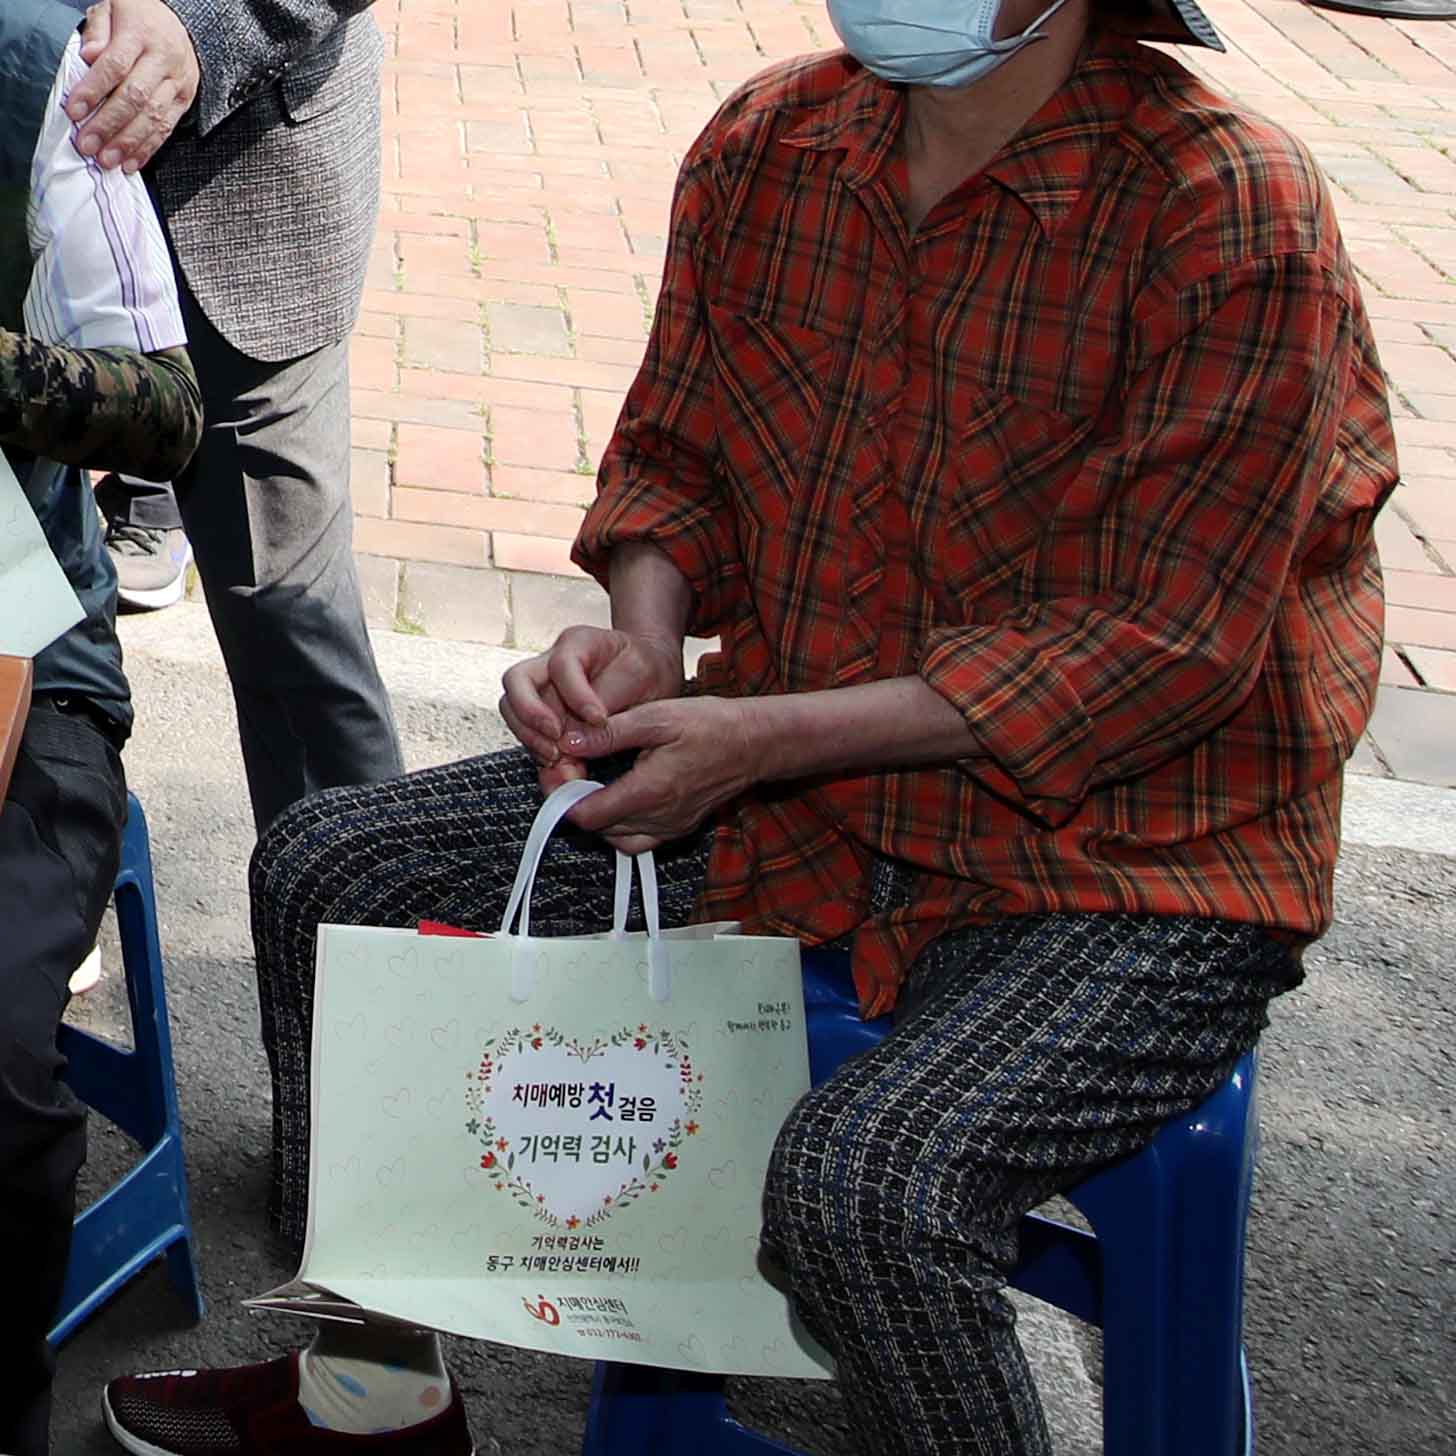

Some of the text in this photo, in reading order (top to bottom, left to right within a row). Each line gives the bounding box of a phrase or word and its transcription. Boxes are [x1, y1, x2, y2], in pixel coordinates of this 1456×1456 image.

[512, 1082, 585, 1108] 치매예방
[519, 1134, 637, 1165] 기억력 검사
[531, 1235, 605, 1251] 기억력검사는
[486, 1255, 515, 1272] 동구
